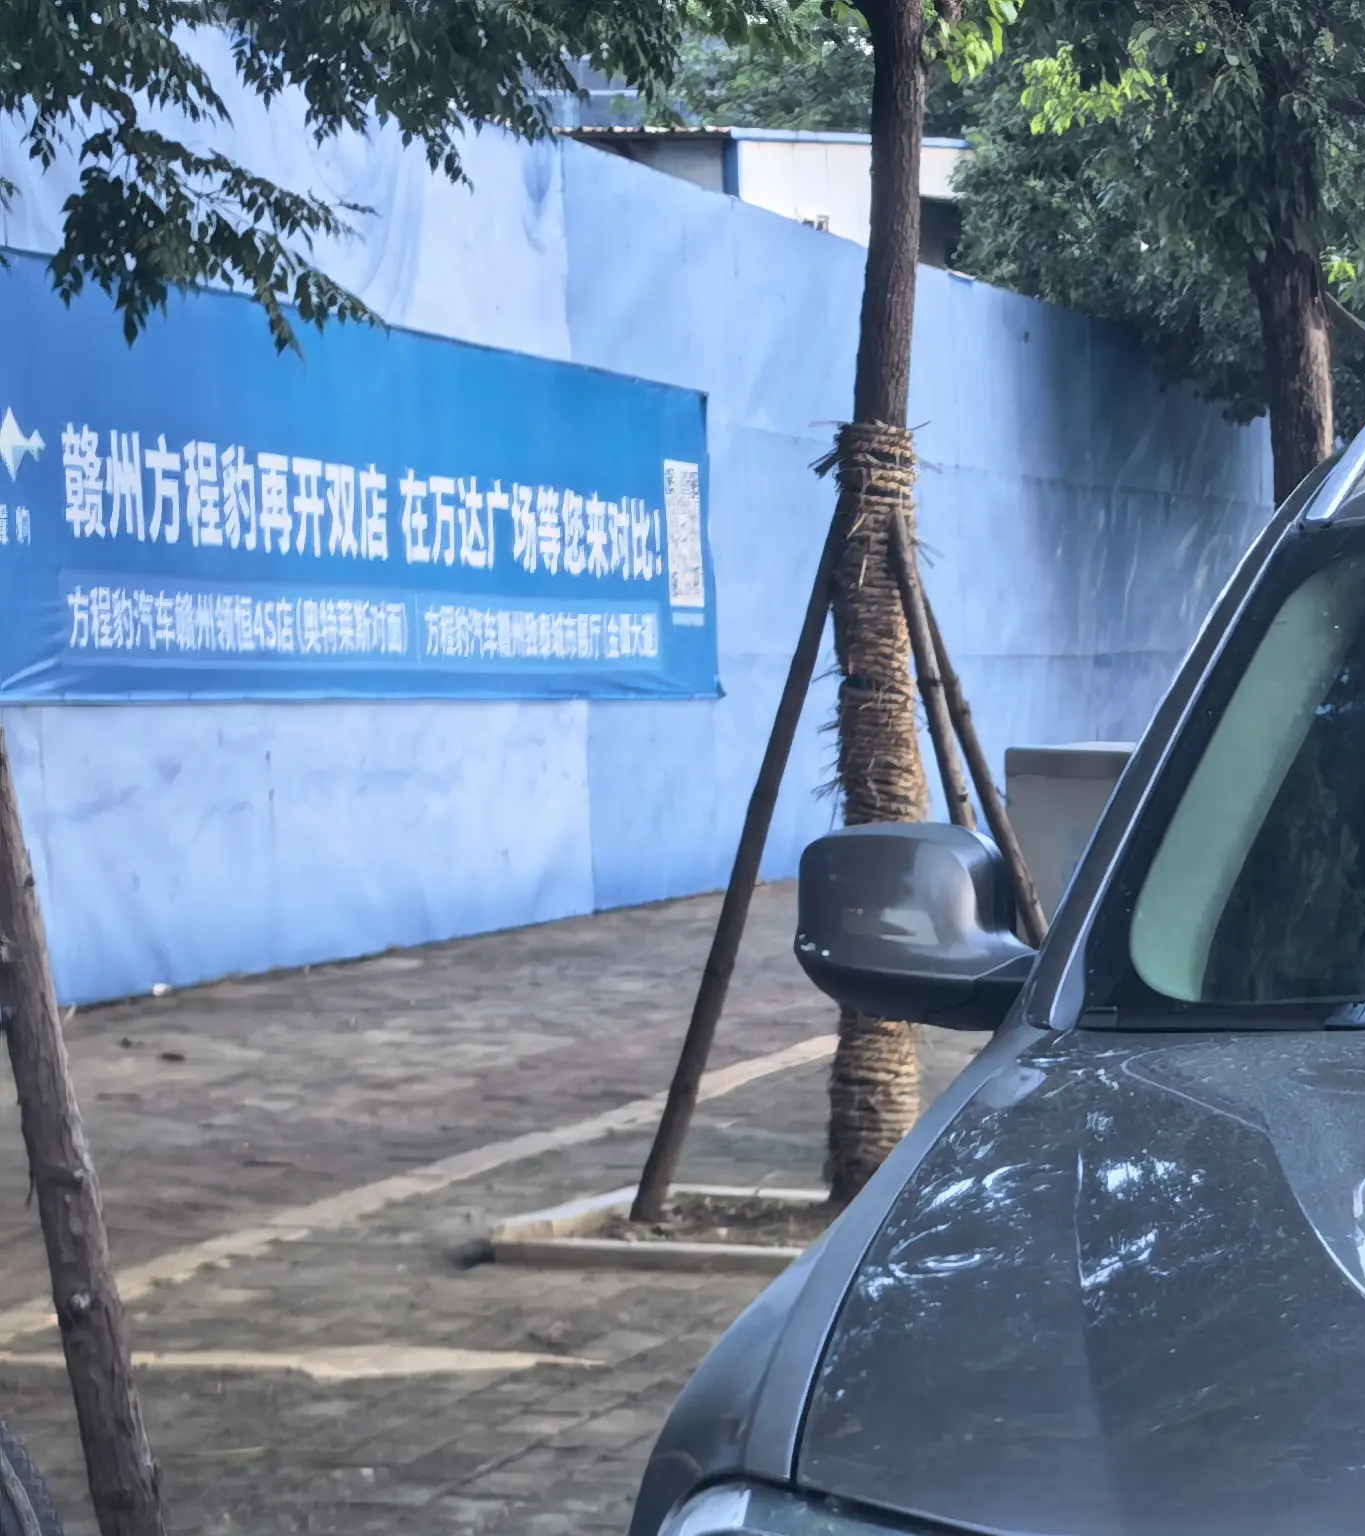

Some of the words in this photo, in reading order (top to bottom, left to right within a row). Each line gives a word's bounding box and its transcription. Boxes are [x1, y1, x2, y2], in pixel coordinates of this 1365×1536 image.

[61, 421, 389, 562] 赣州方程豹再开双店
